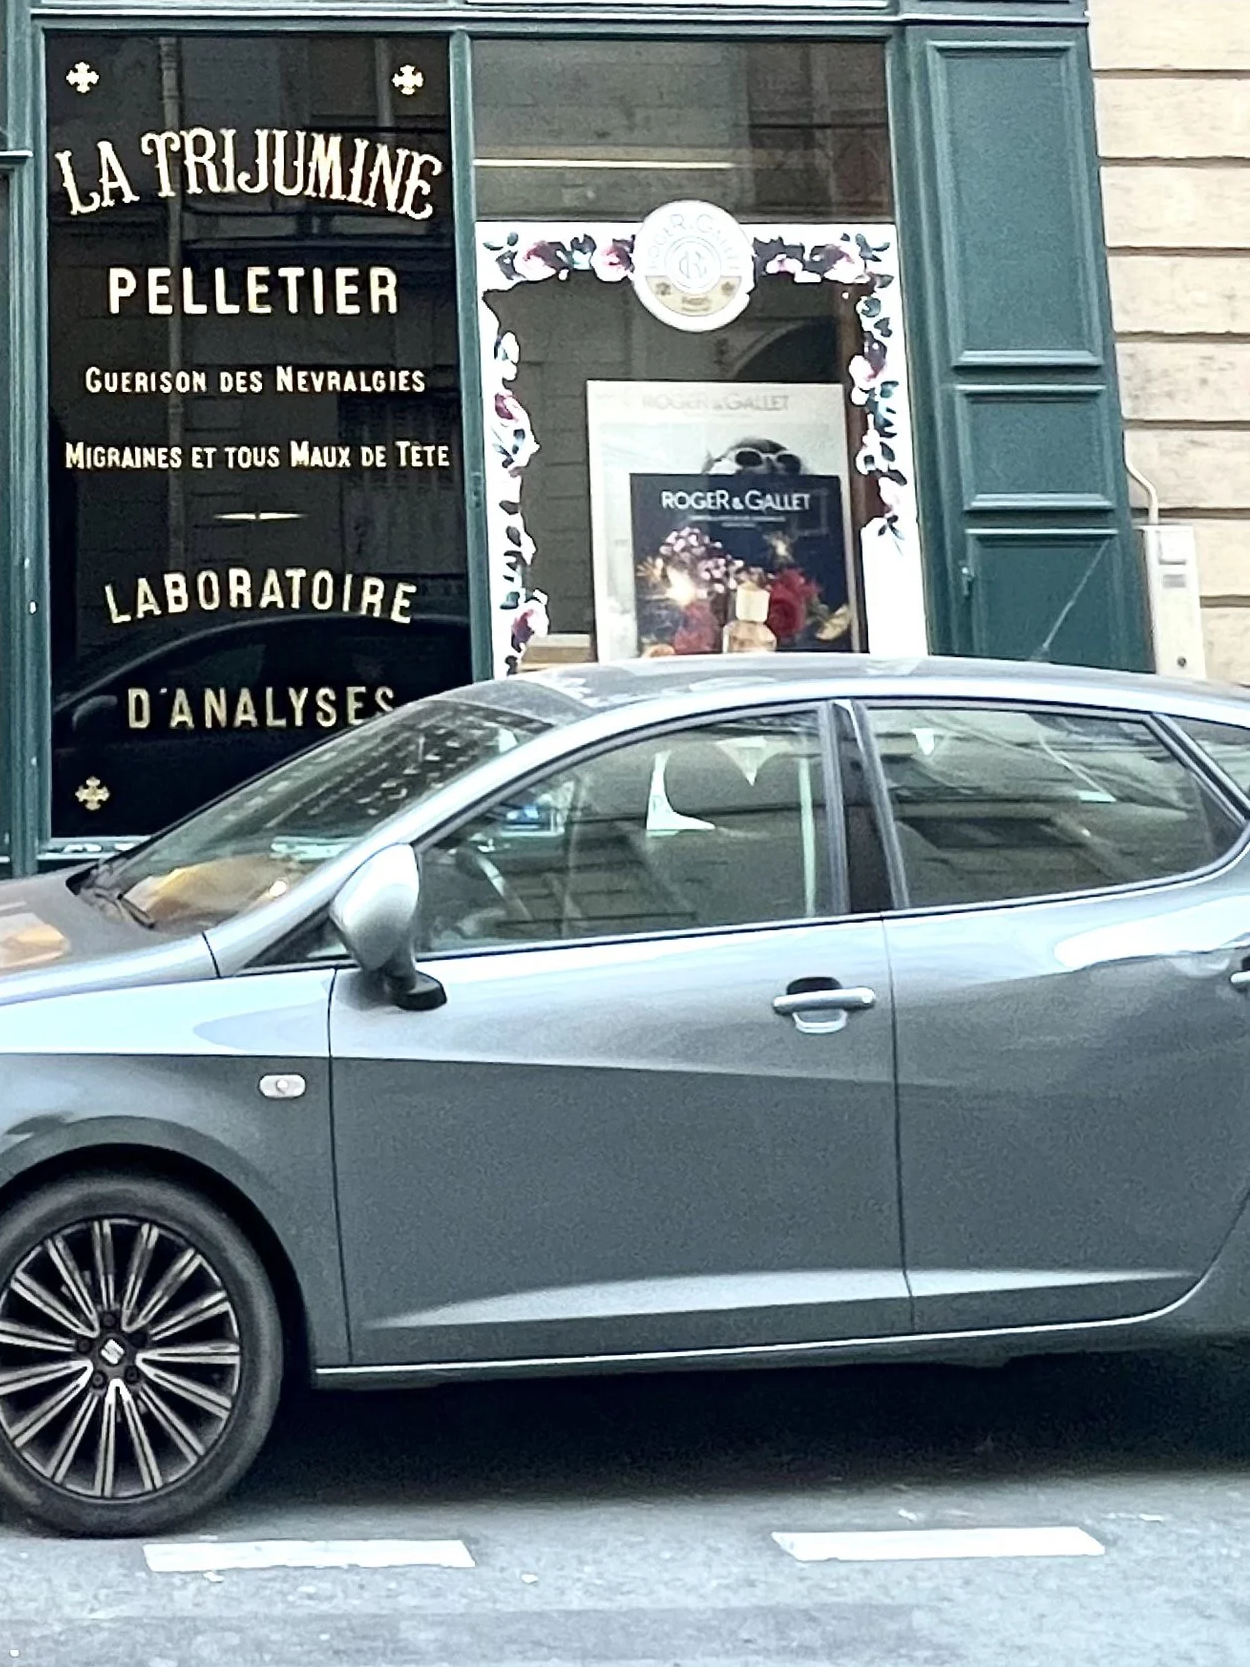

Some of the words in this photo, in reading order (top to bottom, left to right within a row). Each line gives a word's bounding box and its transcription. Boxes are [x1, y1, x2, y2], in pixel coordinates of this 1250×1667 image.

[55, 139, 139, 216] LA
[141, 126, 443, 220] TRIJUMINE
[108, 266, 399, 315] PELLETIER
[85, 366, 207, 394] GUERISON
[276, 365, 425, 393] NEVRALGIES
[725, 393, 790, 411] GALLET
[65, 441, 182, 469] MIGRAINES
[290, 440, 351, 468] MAUX
[661, 489, 730, 510] ROGER
[732, 497, 744, 510] &
[745, 489, 810, 511] GALLET
[104, 566, 417, 624] LABORATOIRE
[128, 685, 395, 729] D'ANALYSES
